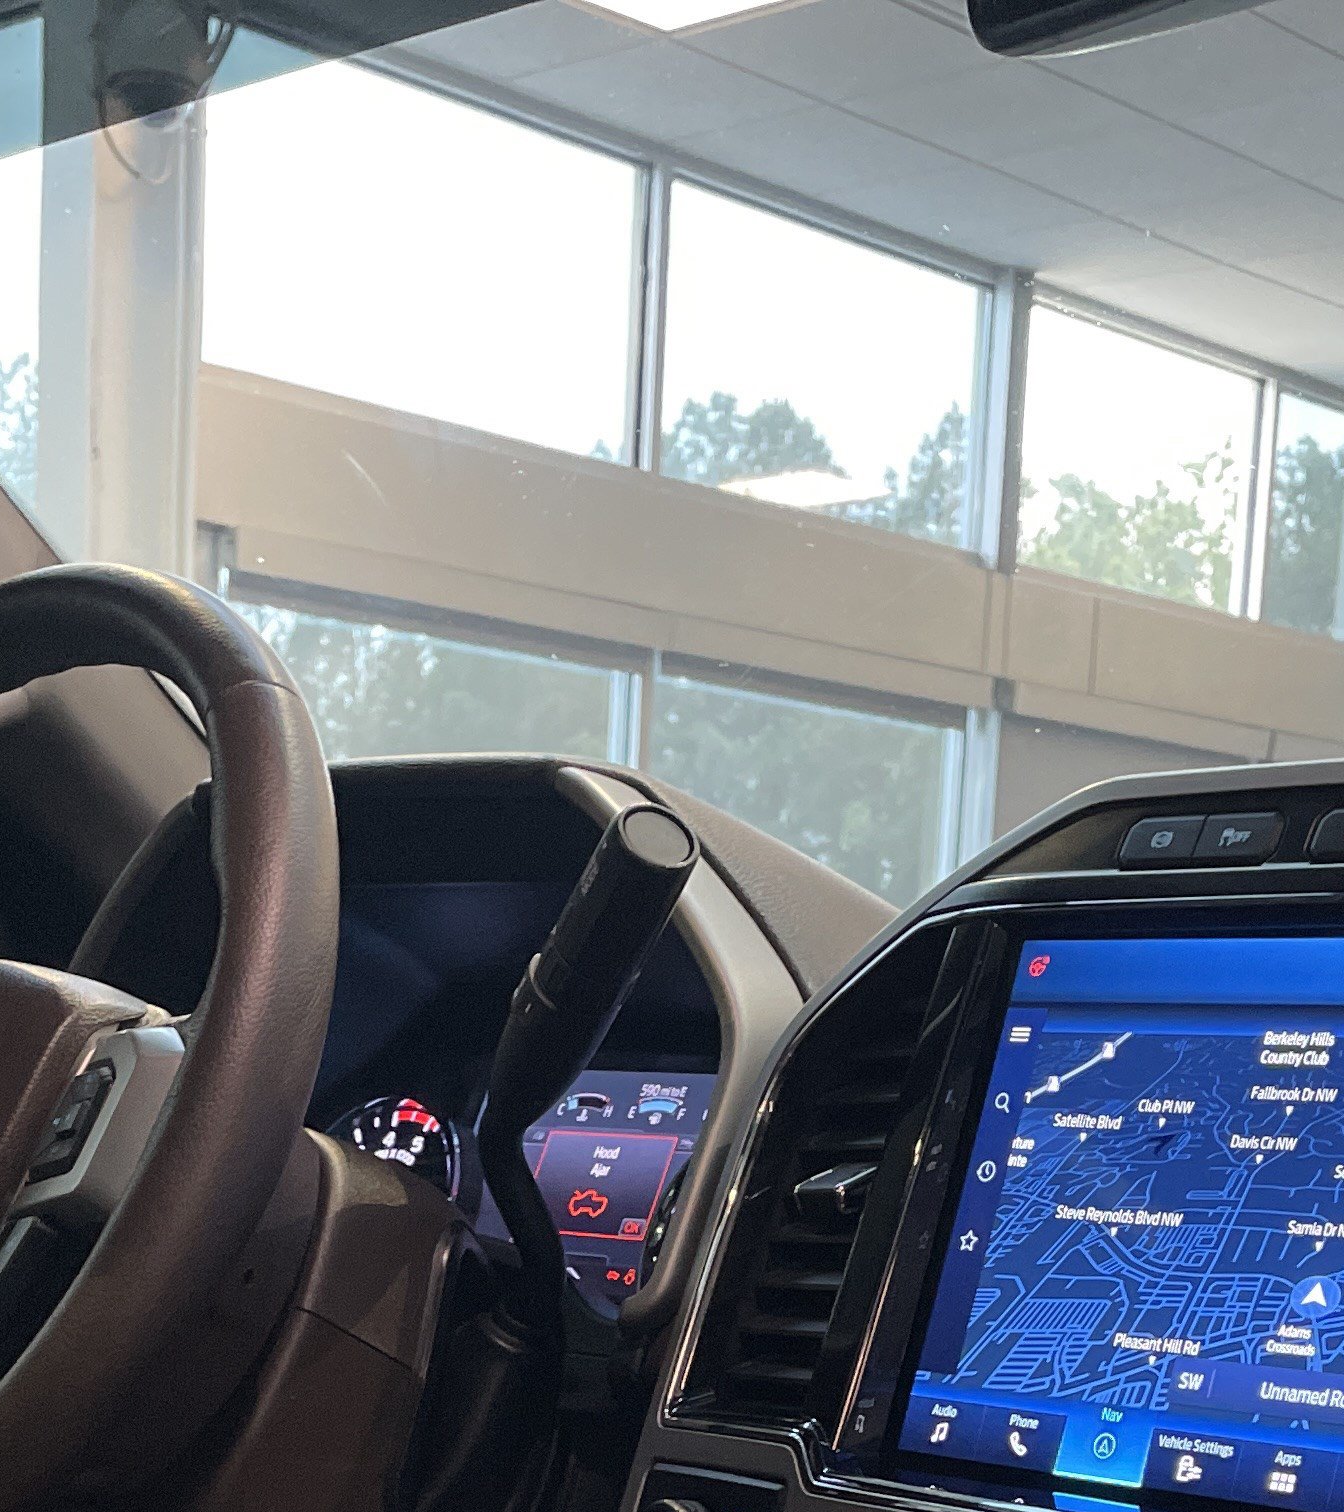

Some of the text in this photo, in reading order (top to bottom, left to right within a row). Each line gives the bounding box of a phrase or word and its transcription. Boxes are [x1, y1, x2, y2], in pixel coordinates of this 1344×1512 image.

[1263, 1031, 1335, 1048] Berkeley Hills
[1260, 1050, 1330, 1068] Country Club
[1250, 1086, 1338, 1102] Fallbrook Dr NW
[627, 1105, 638, 1119] E
[676, 1108, 687, 1121] F
[1137, 1099, 1160, 1113] Club
[1173, 1101, 1195, 1114] NW
[1053, 1113, 1122, 1130] Satellite Blvd
[1230, 1134, 1298, 1151] Davis Cir NW
[593, 1146, 621, 1159] Hood
[1055, 1204, 1184, 1227] Steve Reynolds Blvd NW
[1323, 1222, 1338, 1237] Dr
[1277, 1324, 1312, 1340] Adams
[1113, 1333, 1201, 1356] Pleasant Hill Rd
[1266, 1339, 1316, 1357] Crossroads
[1178, 1372, 1204, 1391] SW
[1259, 1381, 1328, 1407] Unnamed
[931, 1404, 958, 1418] Audio
[1101, 1407, 1123, 1422] Nav
[1009, 1414, 1039, 1430] Phone
[1159, 1434, 1234, 1459] Vehicle Settings
[1274, 1450, 1302, 1467] Apps
